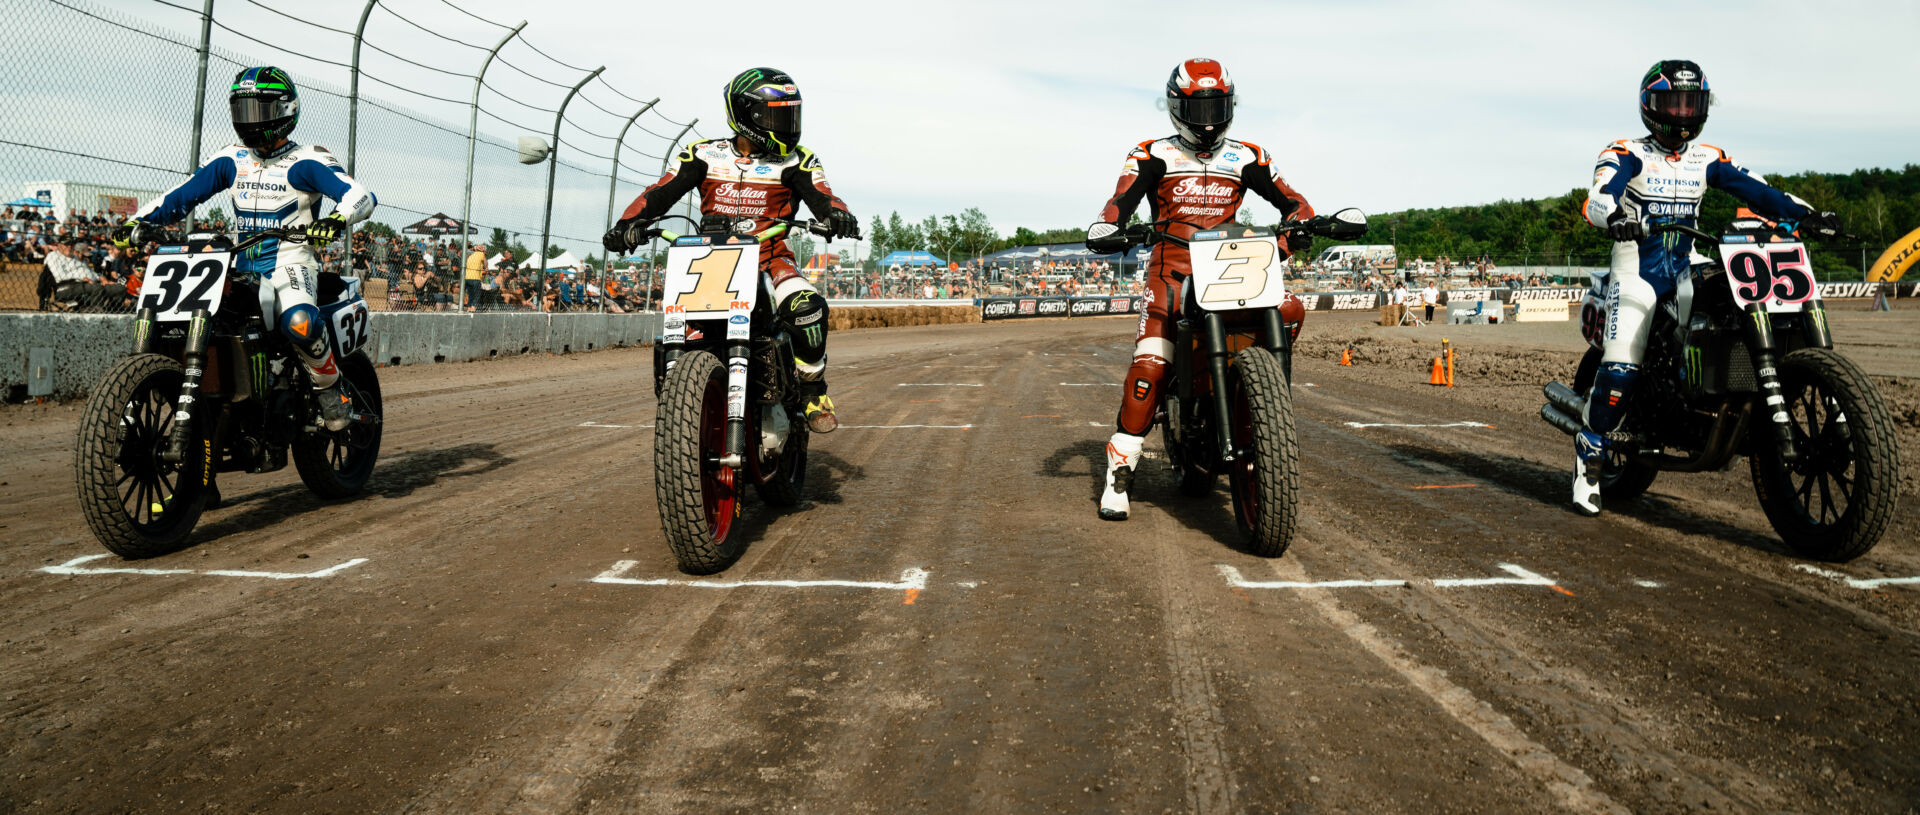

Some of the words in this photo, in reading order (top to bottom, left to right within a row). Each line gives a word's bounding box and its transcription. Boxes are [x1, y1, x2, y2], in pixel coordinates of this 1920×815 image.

[236, 181, 287, 192] ESTENSON
[1172, 177, 1234, 197] Indian
[1647, 177, 1701, 187] ESTENSON
[715, 182, 768, 199] Indian
[714, 196, 747, 205] MOTORCYCLE
[1172, 196, 1213, 204] MOTORCYCLE
[713, 203, 768, 215] PROGRESSIVE
[1177, 206, 1225, 216] PROGRESSIVE
[1659, 204, 1694, 214] YAMAHA
[244, 217, 280, 228] YAMAHA
[1879, 239, 1920, 284] DUNLO
[1200, 240, 1275, 303] 3
[1728, 247, 1815, 304] 95
[141, 259, 224, 313] 32
[674, 247, 744, 312] 1
[1333, 293, 1377, 303] VANCE
[665, 304, 684, 314] RK
[729, 300, 750, 310] RK
[985, 300, 1016, 315] COMETIC
[1038, 300, 1067, 313] COMETIC
[1072, 300, 1107, 313] COMETIC
[1331, 301, 1375, 310] HINES
[1610, 281, 1620, 340] ESTENSON
[340, 306, 368, 355] 32
[203, 439, 211, 486] DUNLOP
